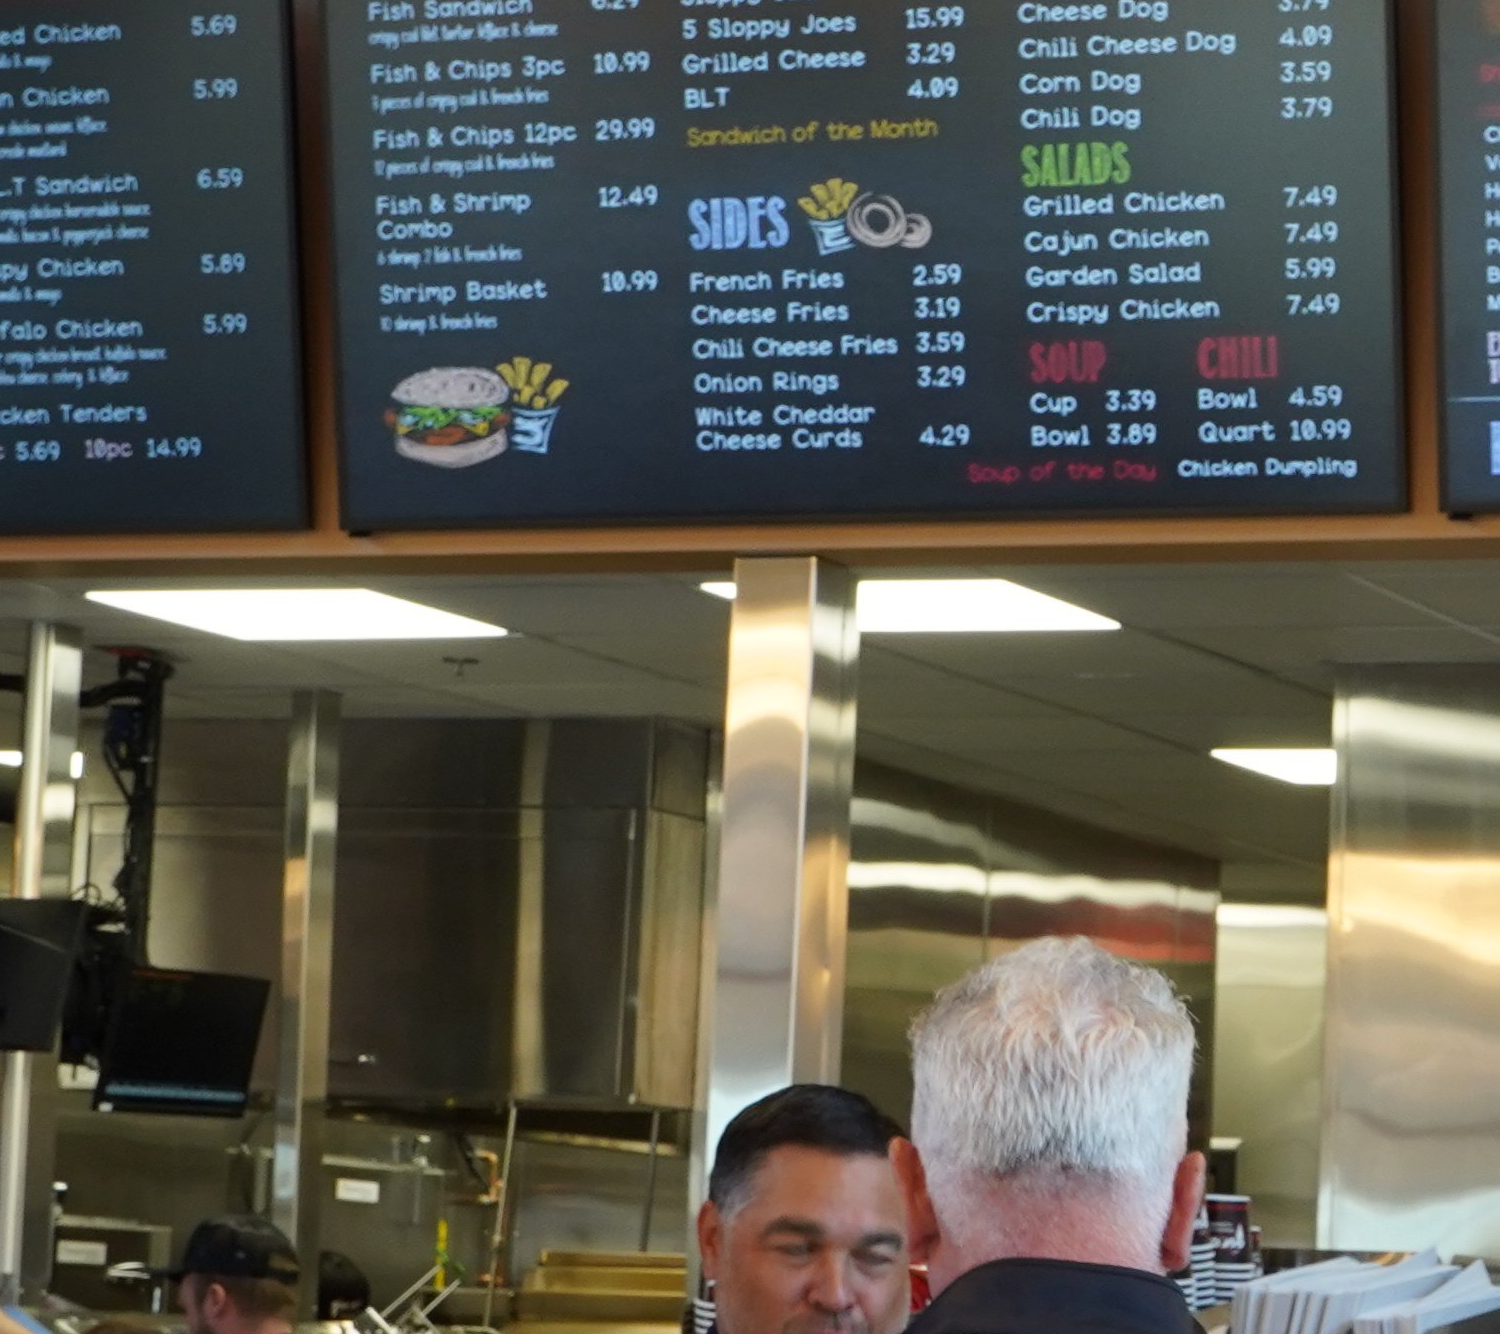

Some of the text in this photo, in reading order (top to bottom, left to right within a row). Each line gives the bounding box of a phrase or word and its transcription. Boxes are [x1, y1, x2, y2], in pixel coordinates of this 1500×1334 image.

[368, 2, 415, 21] Fish
[34, 24, 121, 44] Chicken
[191, 15, 236, 36] 5.69
[684, 87, 730, 109] BLT
[1021, 141, 1131, 187] SALADS
[688, 196, 789, 250] SIDES
[913, 263, 961, 286] 2.59
[1026, 262, 1201, 287] Garden Salad
[1285, 257, 1335, 279] 5.99
[602, 270, 658, 292] 10.99
[690, 269, 844, 292] French Fries
[380, 280, 547, 305] Shrimp Basket
[1029, 340, 1107, 383] SOUP
[1197, 335, 1278, 379] CHILI
[60, 404, 147, 423] Tenders
[1199, 419, 1351, 443] Quart 10.99
[15, 441, 60, 461] 5.69
[147, 437, 201, 458] 14.99
[1178, 457, 1357, 477] Chicken Dumpling
